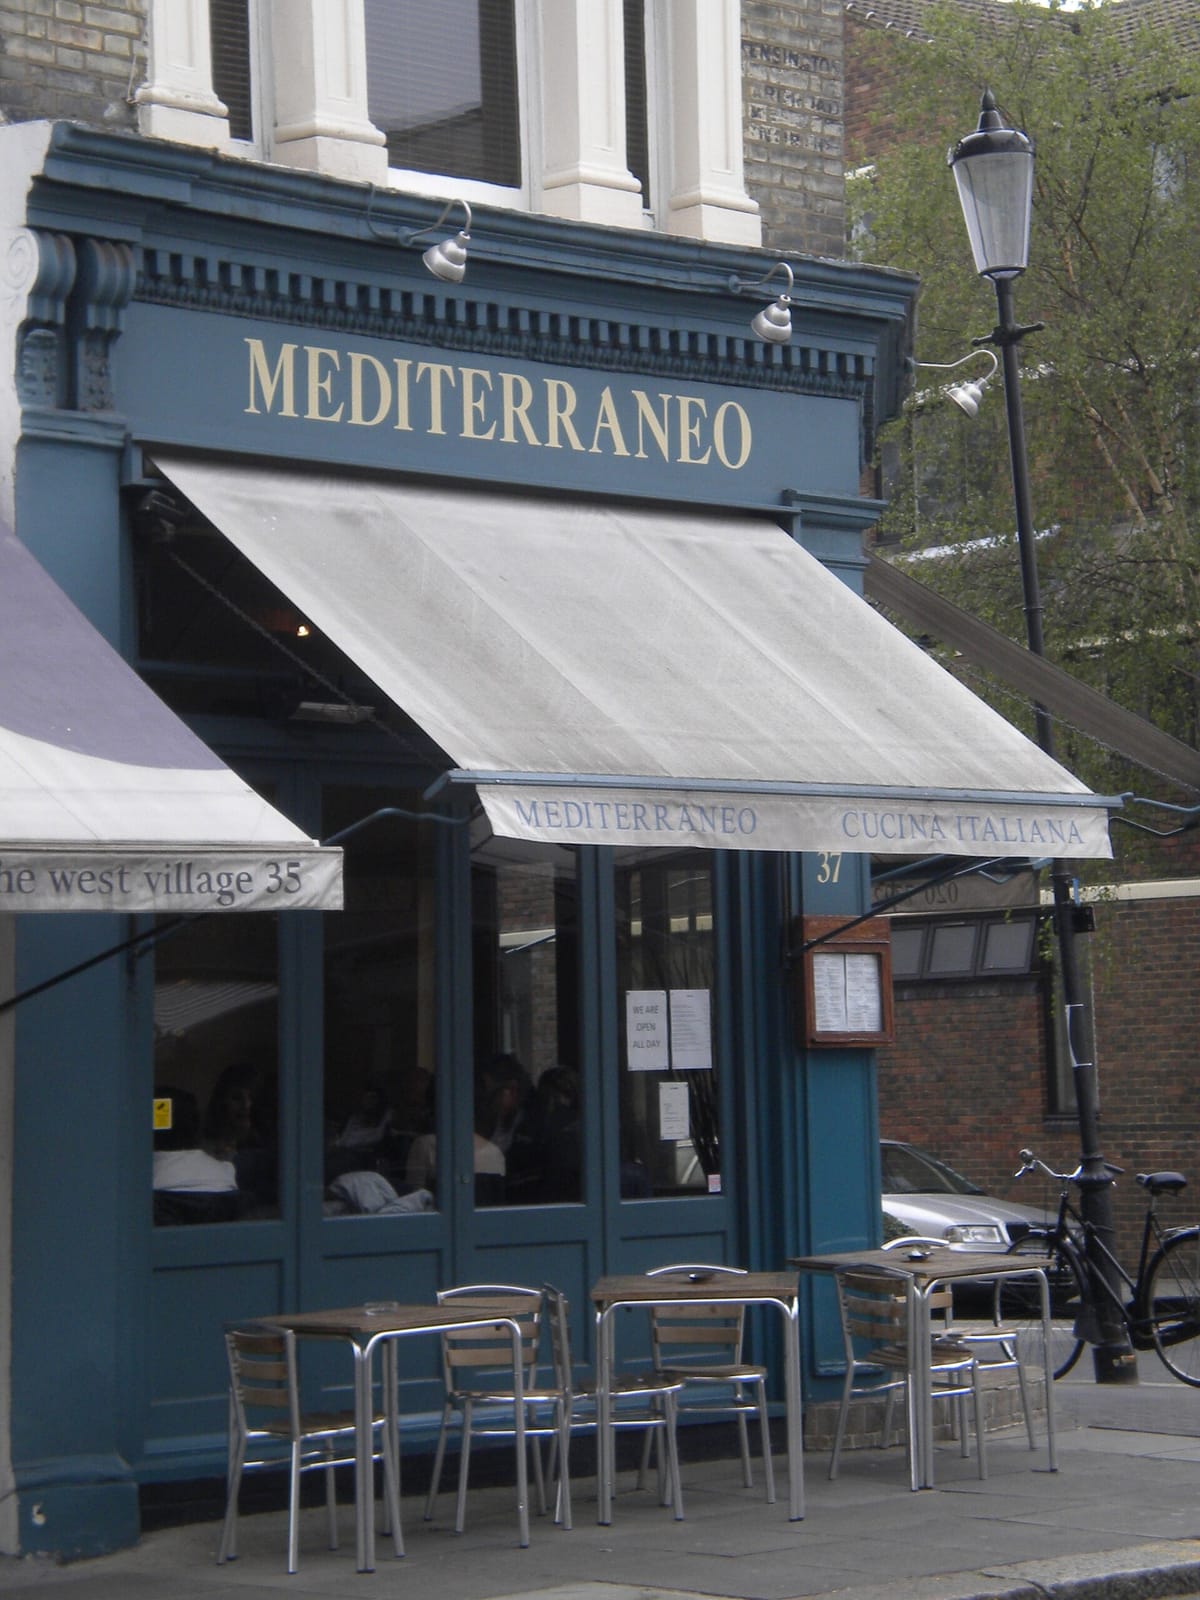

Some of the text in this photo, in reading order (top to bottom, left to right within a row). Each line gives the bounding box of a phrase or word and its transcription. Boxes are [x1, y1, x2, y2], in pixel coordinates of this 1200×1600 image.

[243, 338, 753, 470] MEDITERRANEO
[513, 799, 757, 835] MEDITERRANEO
[841, 811, 1085, 845] CUCINA ITALIANA
[816, 851, 843, 884] 37
[48, 865, 131, 895] west
[143, 862, 254, 907] village
[265, 862, 302, 894] 35
[632, 1005, 659, 1014] WE ARE
[635, 1022, 657, 1032] OPEN
[632, 1040, 660, 1049] ALL DAY
